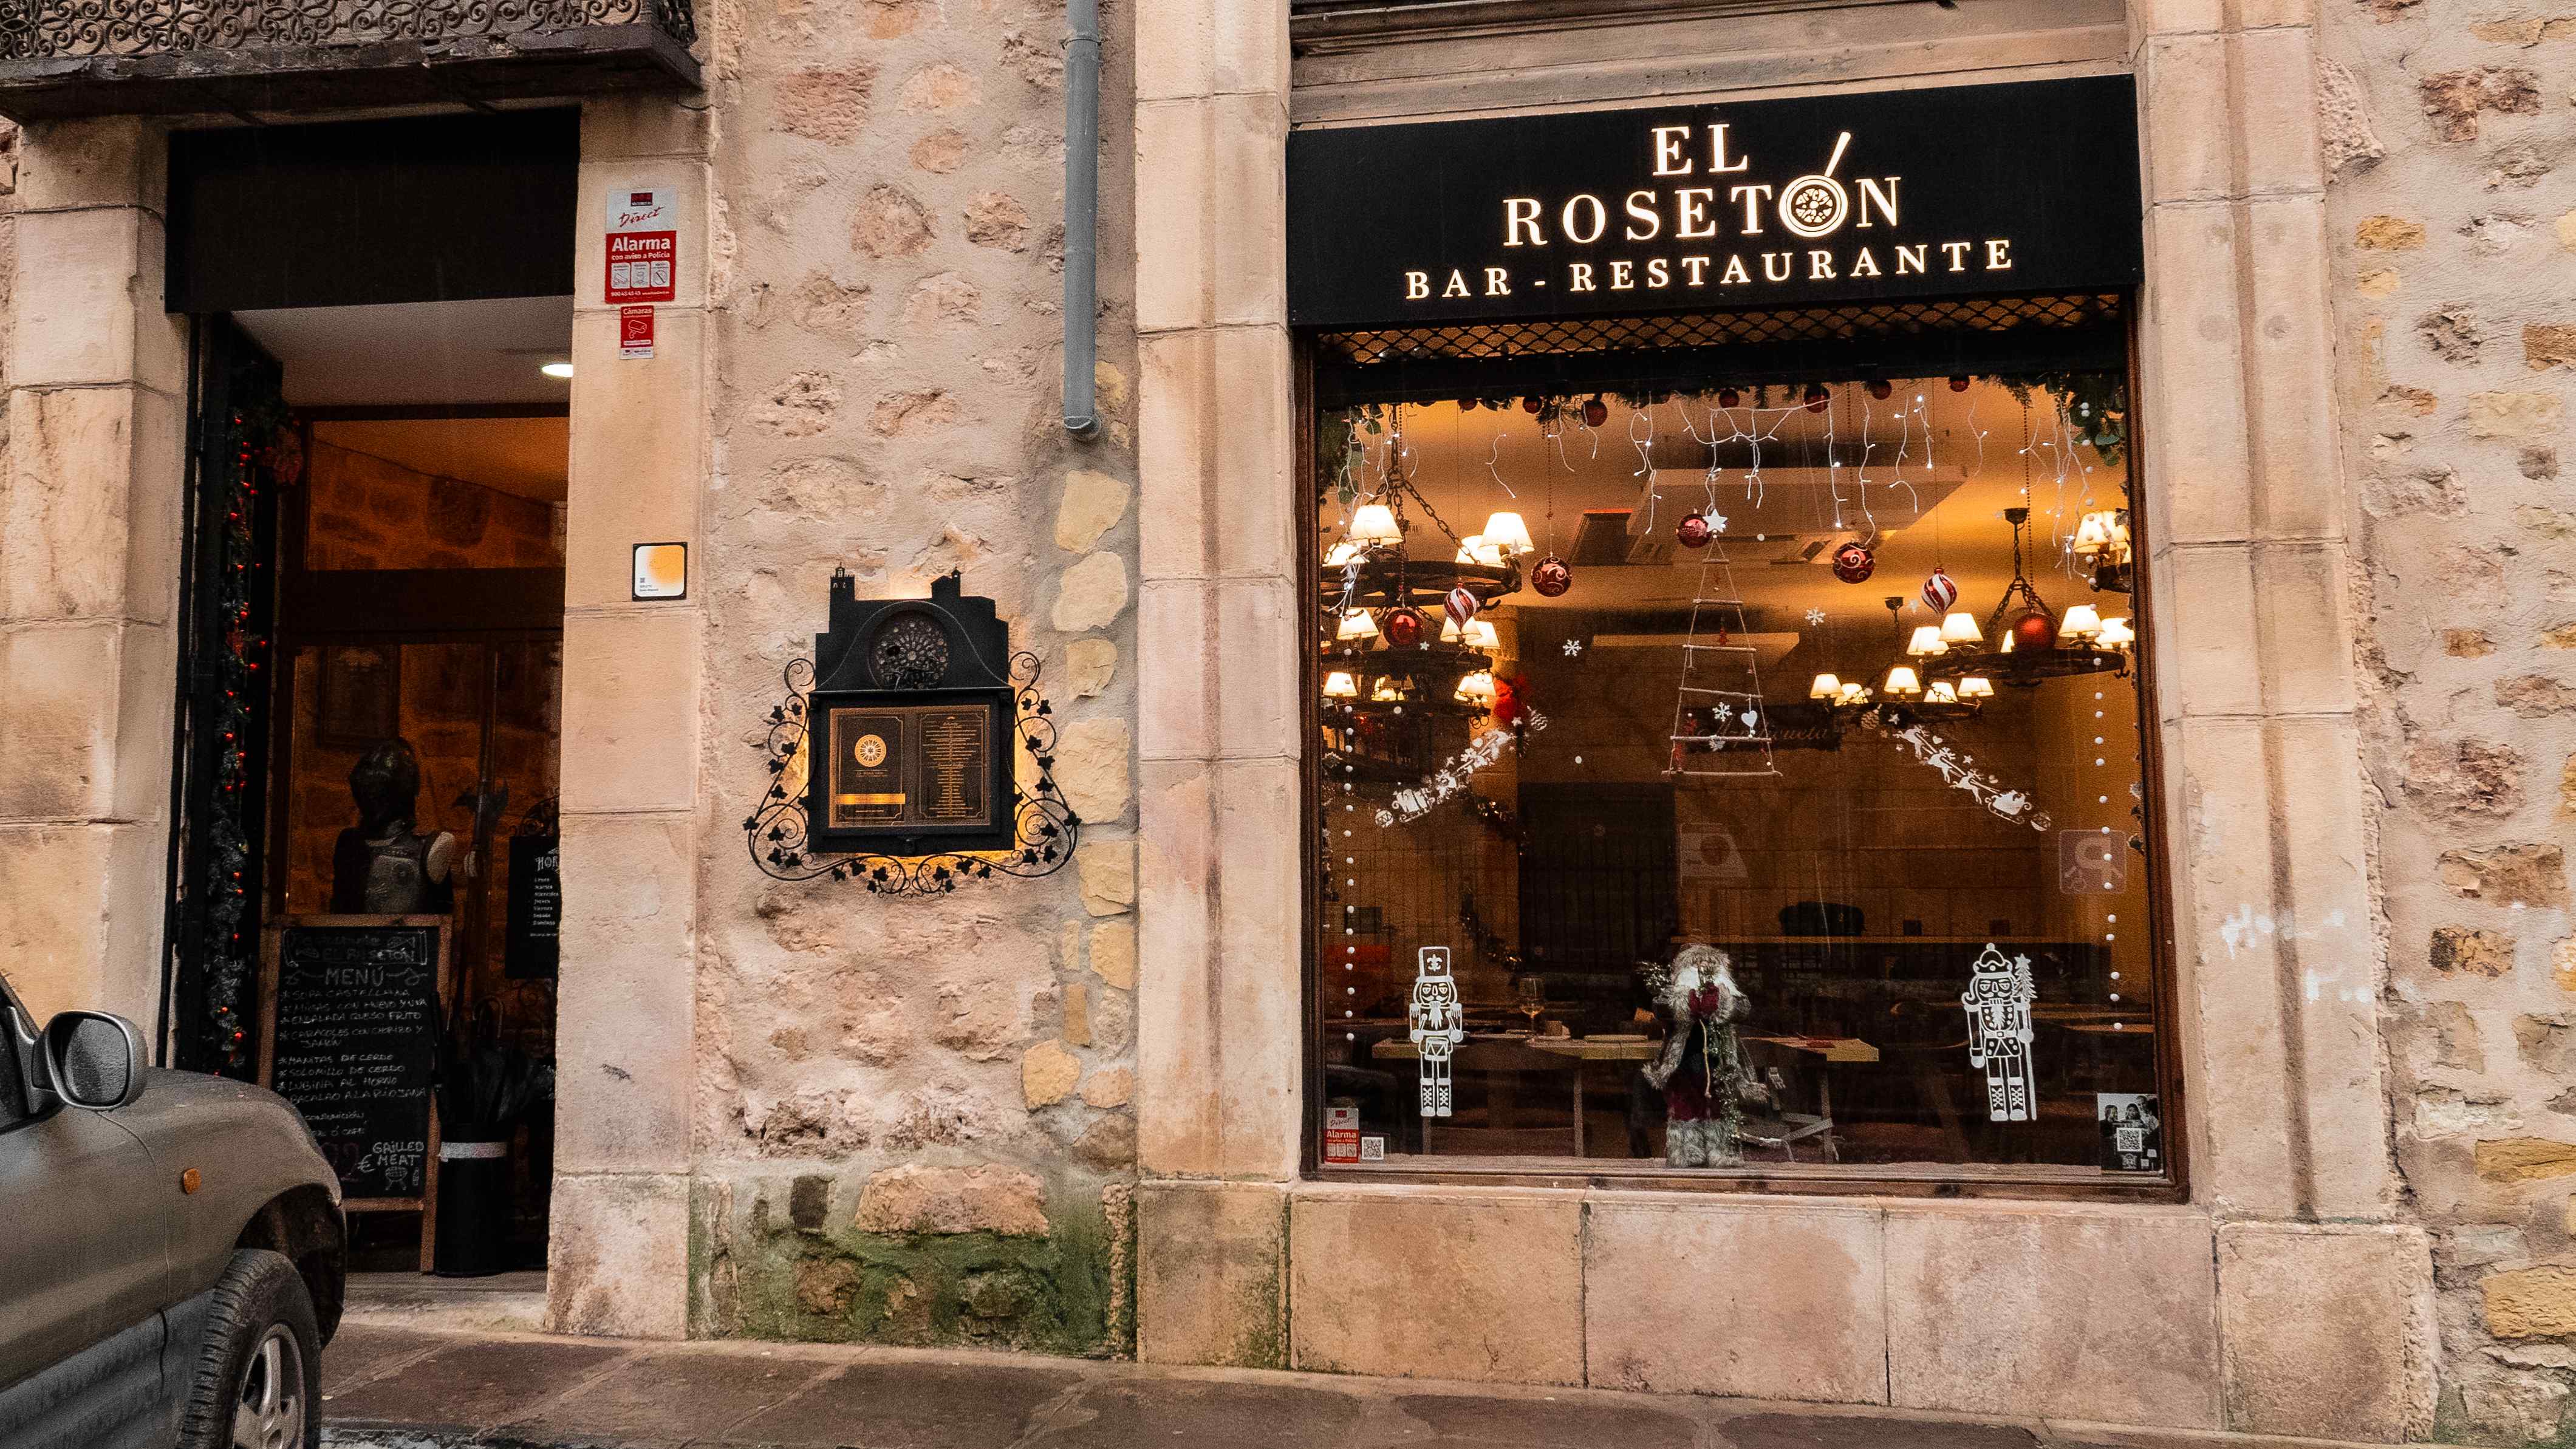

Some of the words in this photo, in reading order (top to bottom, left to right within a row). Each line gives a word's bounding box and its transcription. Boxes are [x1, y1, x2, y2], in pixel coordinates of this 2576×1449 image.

[1651, 123, 1748, 176] EL
[1503, 132, 1902, 247] ROSETÓN
[618, 206, 664, 228] Direct
[612, 237, 671, 252] Alarma
[1405, 267, 1511, 299] BAR
[1569, 239, 2012, 292] RESTAURANTE
[325, 966, 384, 987] MENÚ
[388, 1011, 422, 1021] FRITO
[349, 1066, 364, 1074] DE
[367, 1065, 406, 1074] CERDO
[363, 1076, 397, 1087] HORNO
[1327, 1130, 1356, 1139] Alarma
[376, 1153, 421, 1166] MEAT
